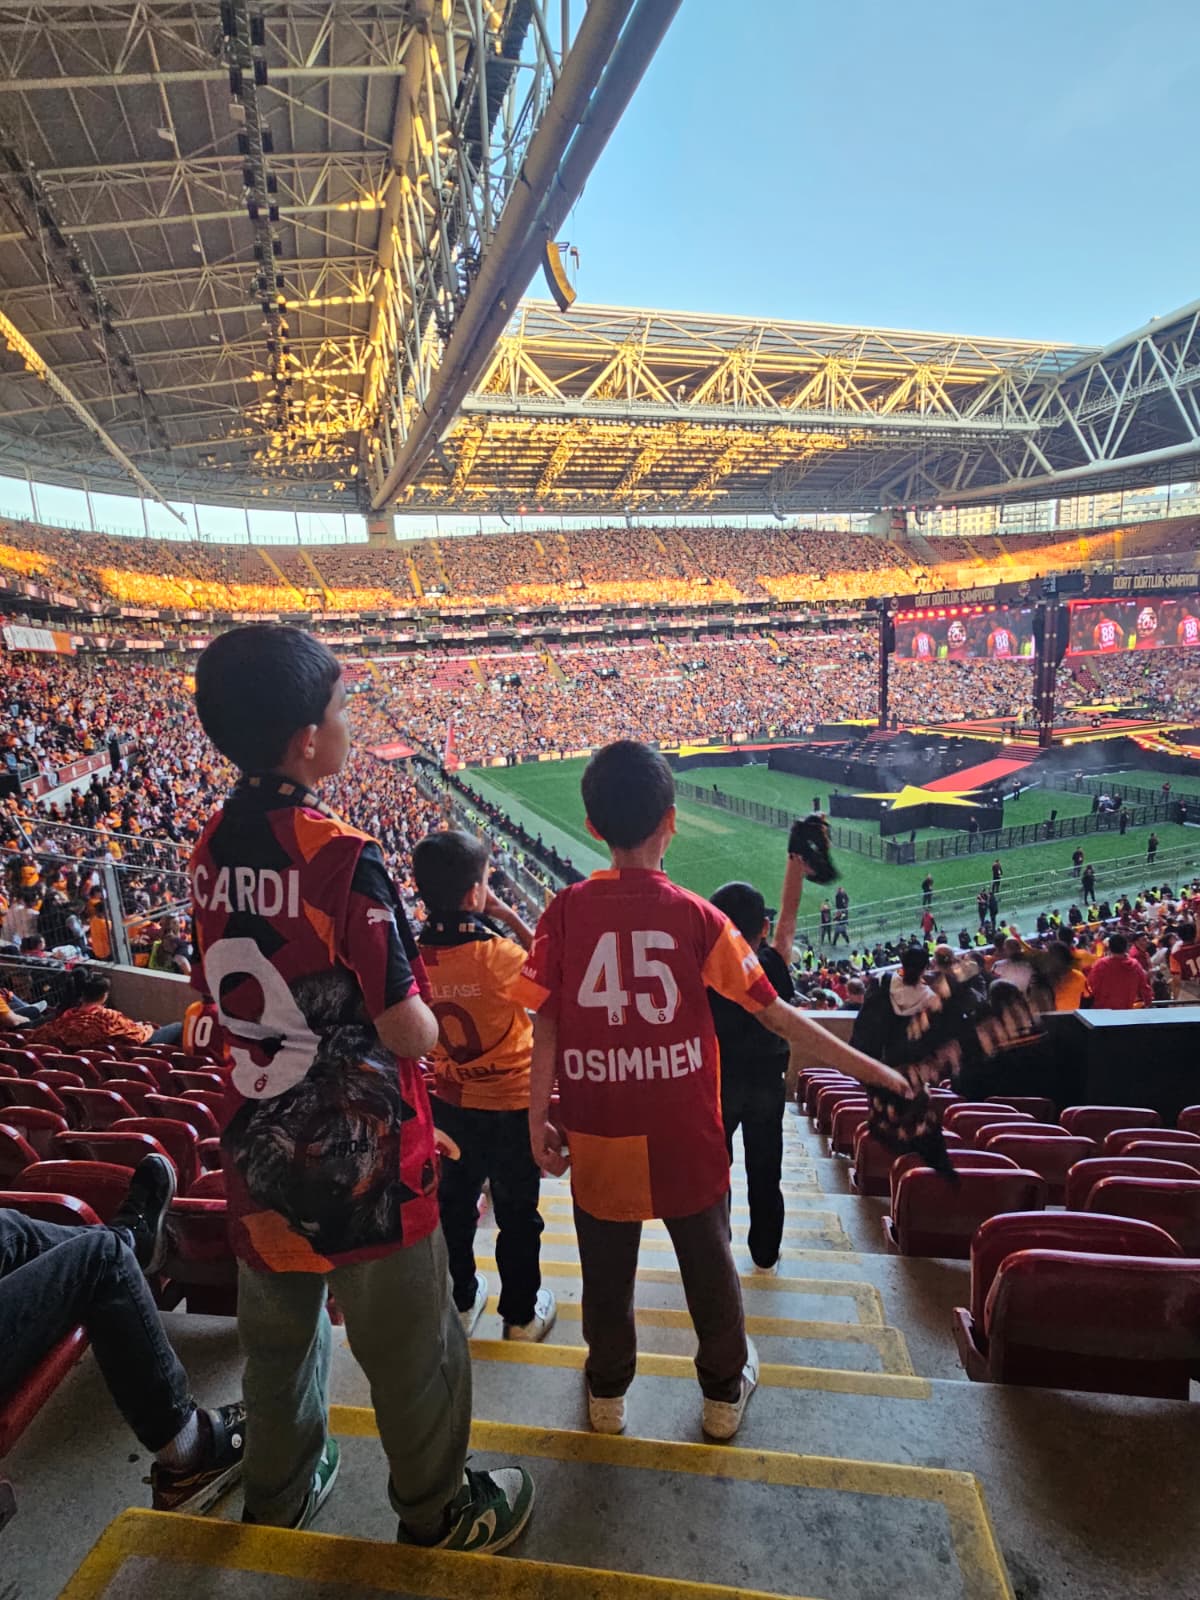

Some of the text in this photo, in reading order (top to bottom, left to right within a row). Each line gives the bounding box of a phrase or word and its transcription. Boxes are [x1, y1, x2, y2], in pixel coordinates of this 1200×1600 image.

[577, 930, 680, 1025] 45
[187, 1014, 213, 1048] 10
[563, 1037, 703, 1083] OSIMHEN
